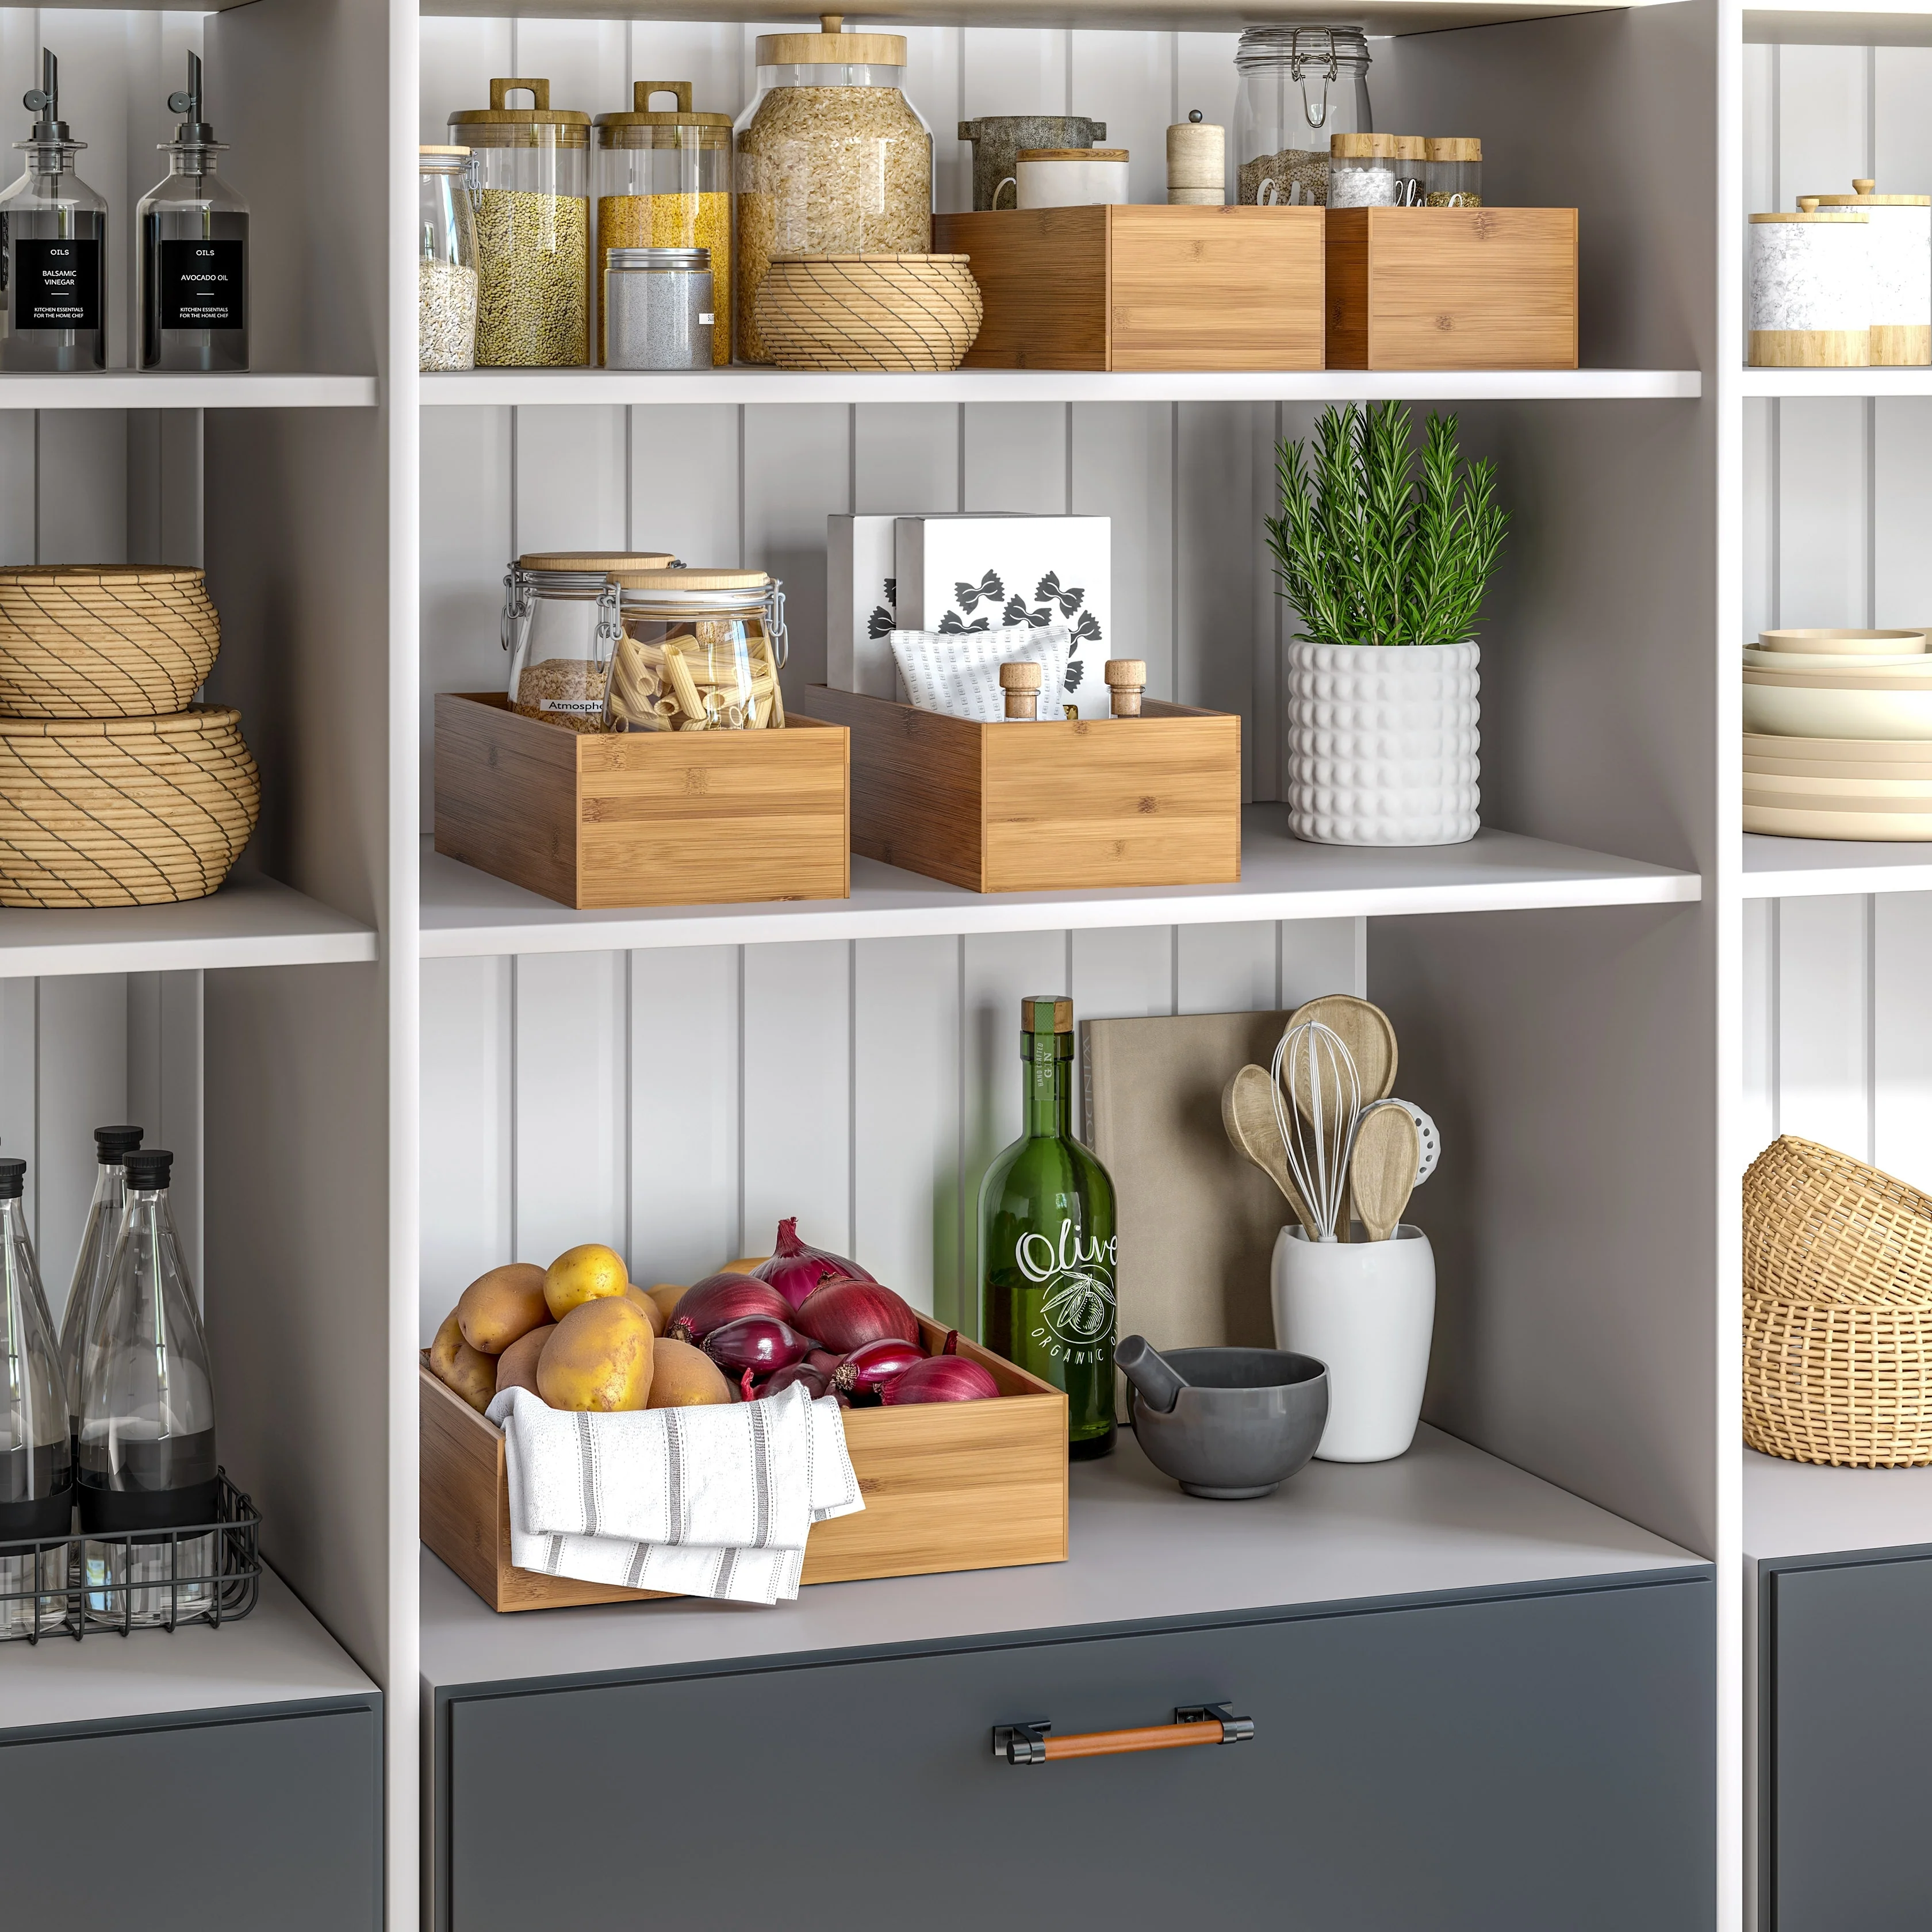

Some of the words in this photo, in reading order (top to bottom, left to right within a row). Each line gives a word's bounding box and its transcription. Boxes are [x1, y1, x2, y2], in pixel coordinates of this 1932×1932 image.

[1044, 1052, 1052, 1078] GIN
[1015, 1218, 1118, 1282] Olive
[1032, 1327, 1104, 1365] ORGANIC
